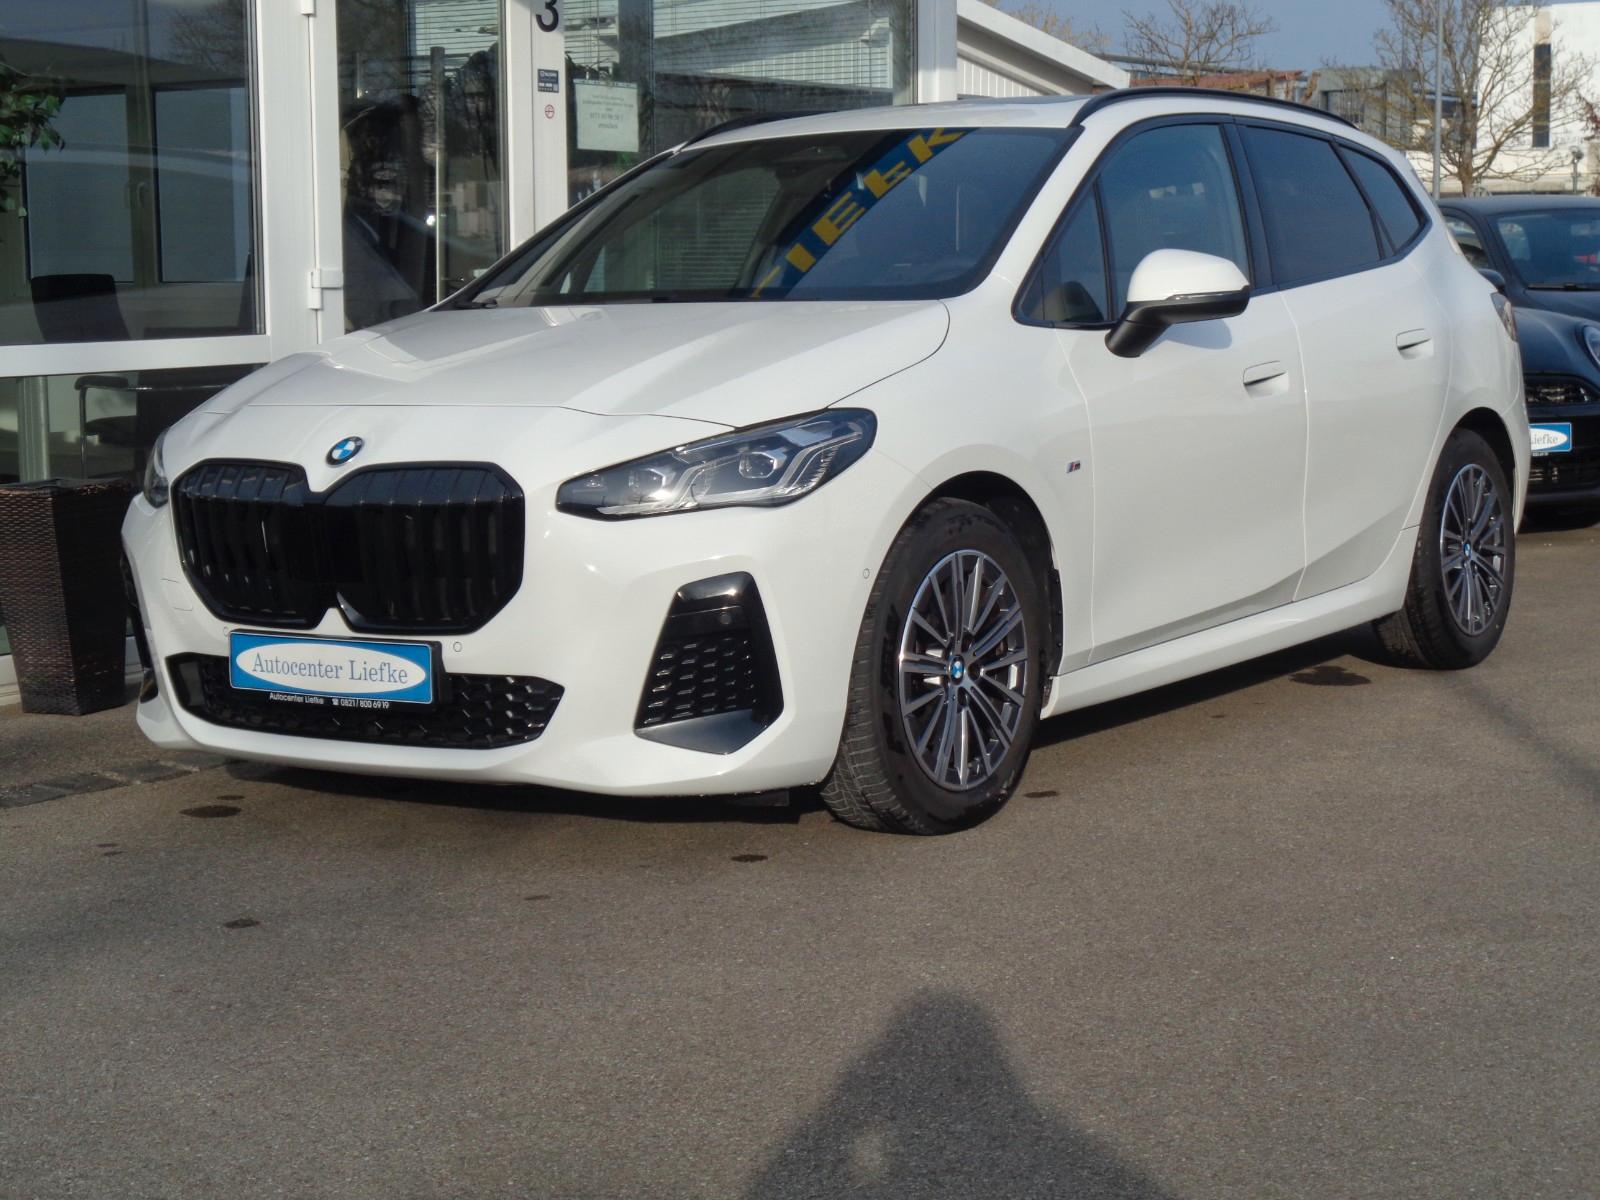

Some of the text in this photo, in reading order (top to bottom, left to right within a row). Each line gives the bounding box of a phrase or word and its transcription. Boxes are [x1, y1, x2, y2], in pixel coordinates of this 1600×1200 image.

[536, 0, 559, 32] 3
[252, 653, 408, 684] Autocenter Liefke
